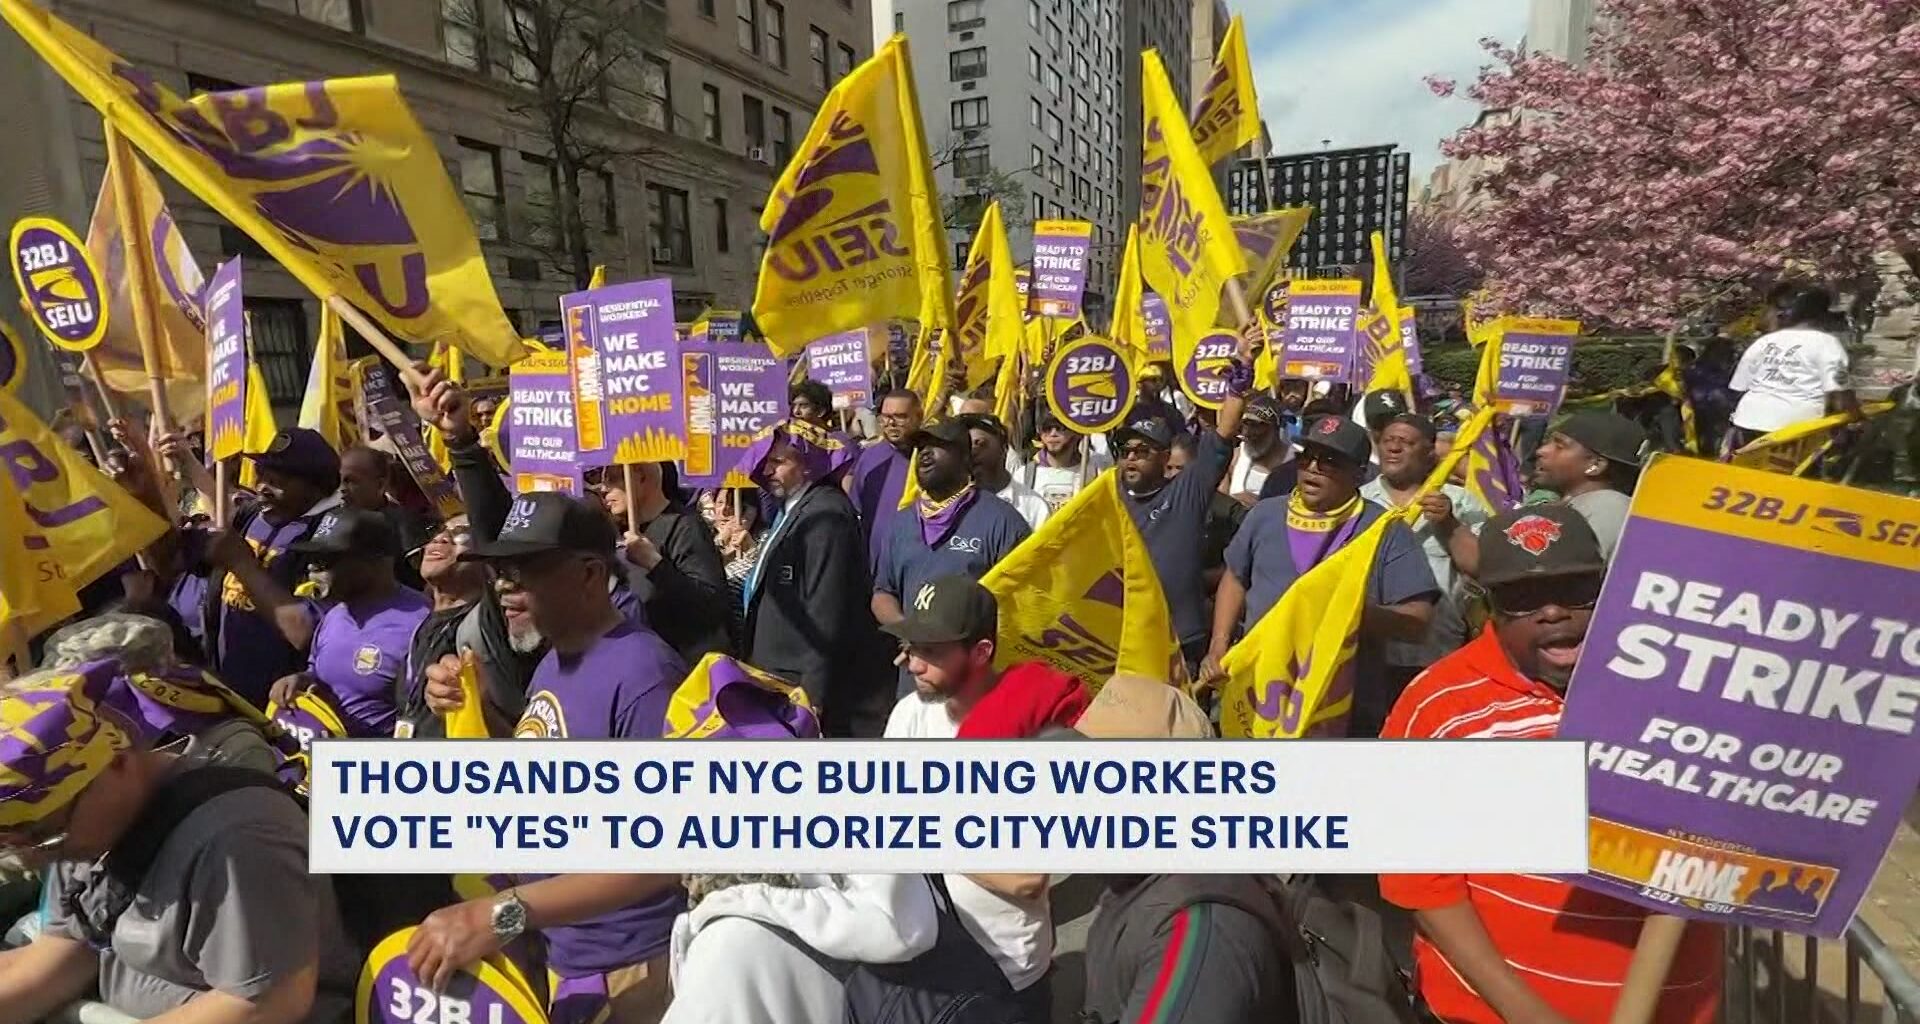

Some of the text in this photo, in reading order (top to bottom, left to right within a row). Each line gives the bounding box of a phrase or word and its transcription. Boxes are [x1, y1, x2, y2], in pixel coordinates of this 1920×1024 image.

[20, 241, 69, 271] 32BJ
[1069, 246, 1084, 255] TO
[1034, 256, 1082, 270] STRIKE
[46, 302, 94, 330] SEIU
[1291, 305, 1352, 316] READY TO
[1289, 318, 1351, 331] STRIKE
[603, 333, 640, 352] WE
[1502, 343, 1568, 355] READY TO
[606, 352, 667, 373] MAKE
[811, 350, 864, 369] STRIKE
[1066, 355, 1116, 375] 32BJ
[1500, 354, 1565, 371] STRIKE
[607, 374, 649, 395] NYC
[721, 383, 755, 397] WE
[1197, 381, 1229, 395] SEI
[513, 390, 556, 404] READY
[609, 393, 673, 416] HOME
[721, 400, 778, 414] MAKE
[1069, 400, 1117, 418] SEIU
[513, 407, 574, 428] STRIKE
[721, 417, 762, 432] NYC
[542, 437, 563, 448] OUR
[721, 434, 752, 448] HO
[515, 448, 577, 462] HEALTHCARE
[1703, 486, 1809, 525] 32BJ
[1631, 571, 1863, 650] READY
[1607, 623, 1920, 734] STRIKE
[1639, 717, 1843, 783] FOR OUR
[1589, 742, 1879, 826] HEALTHCARE
[1648, 848, 1750, 903] HOME
